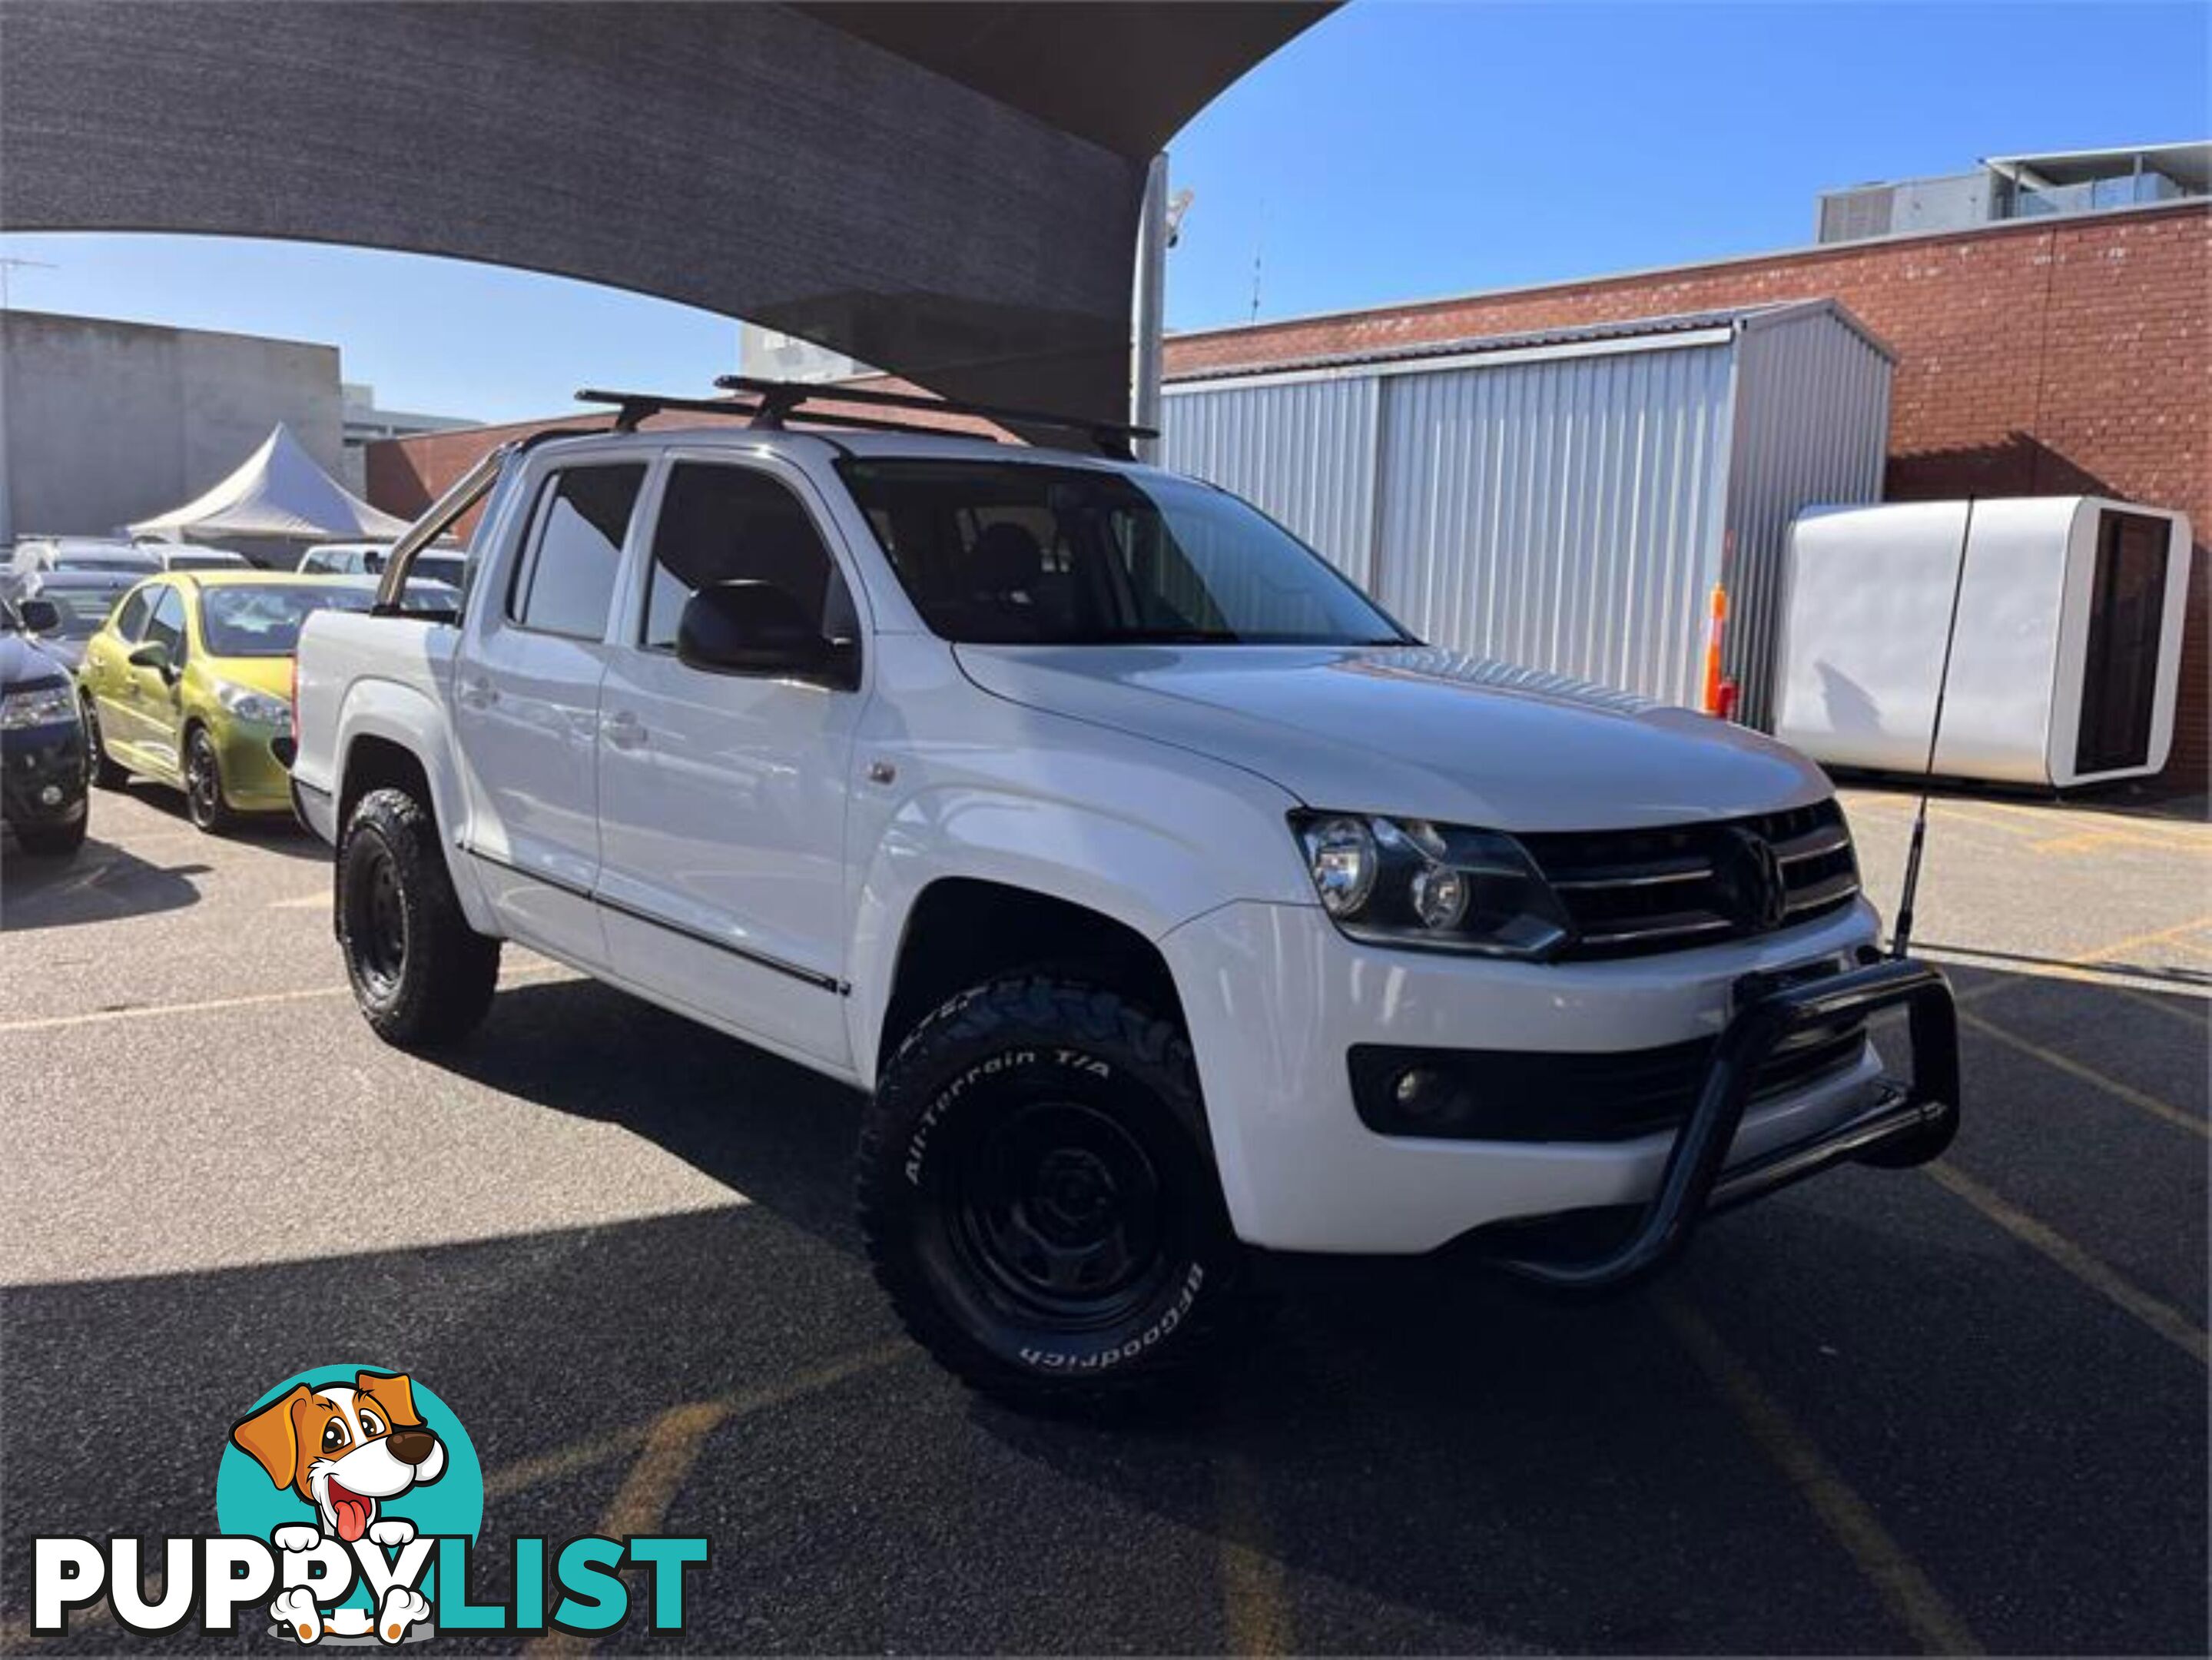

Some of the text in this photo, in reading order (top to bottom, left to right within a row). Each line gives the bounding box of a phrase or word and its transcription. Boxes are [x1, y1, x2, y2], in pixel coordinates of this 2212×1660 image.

[904, 1048, 1109, 1185] All-Terrain T/A
[1019, 1262, 1204, 1368] BFGoodrich
